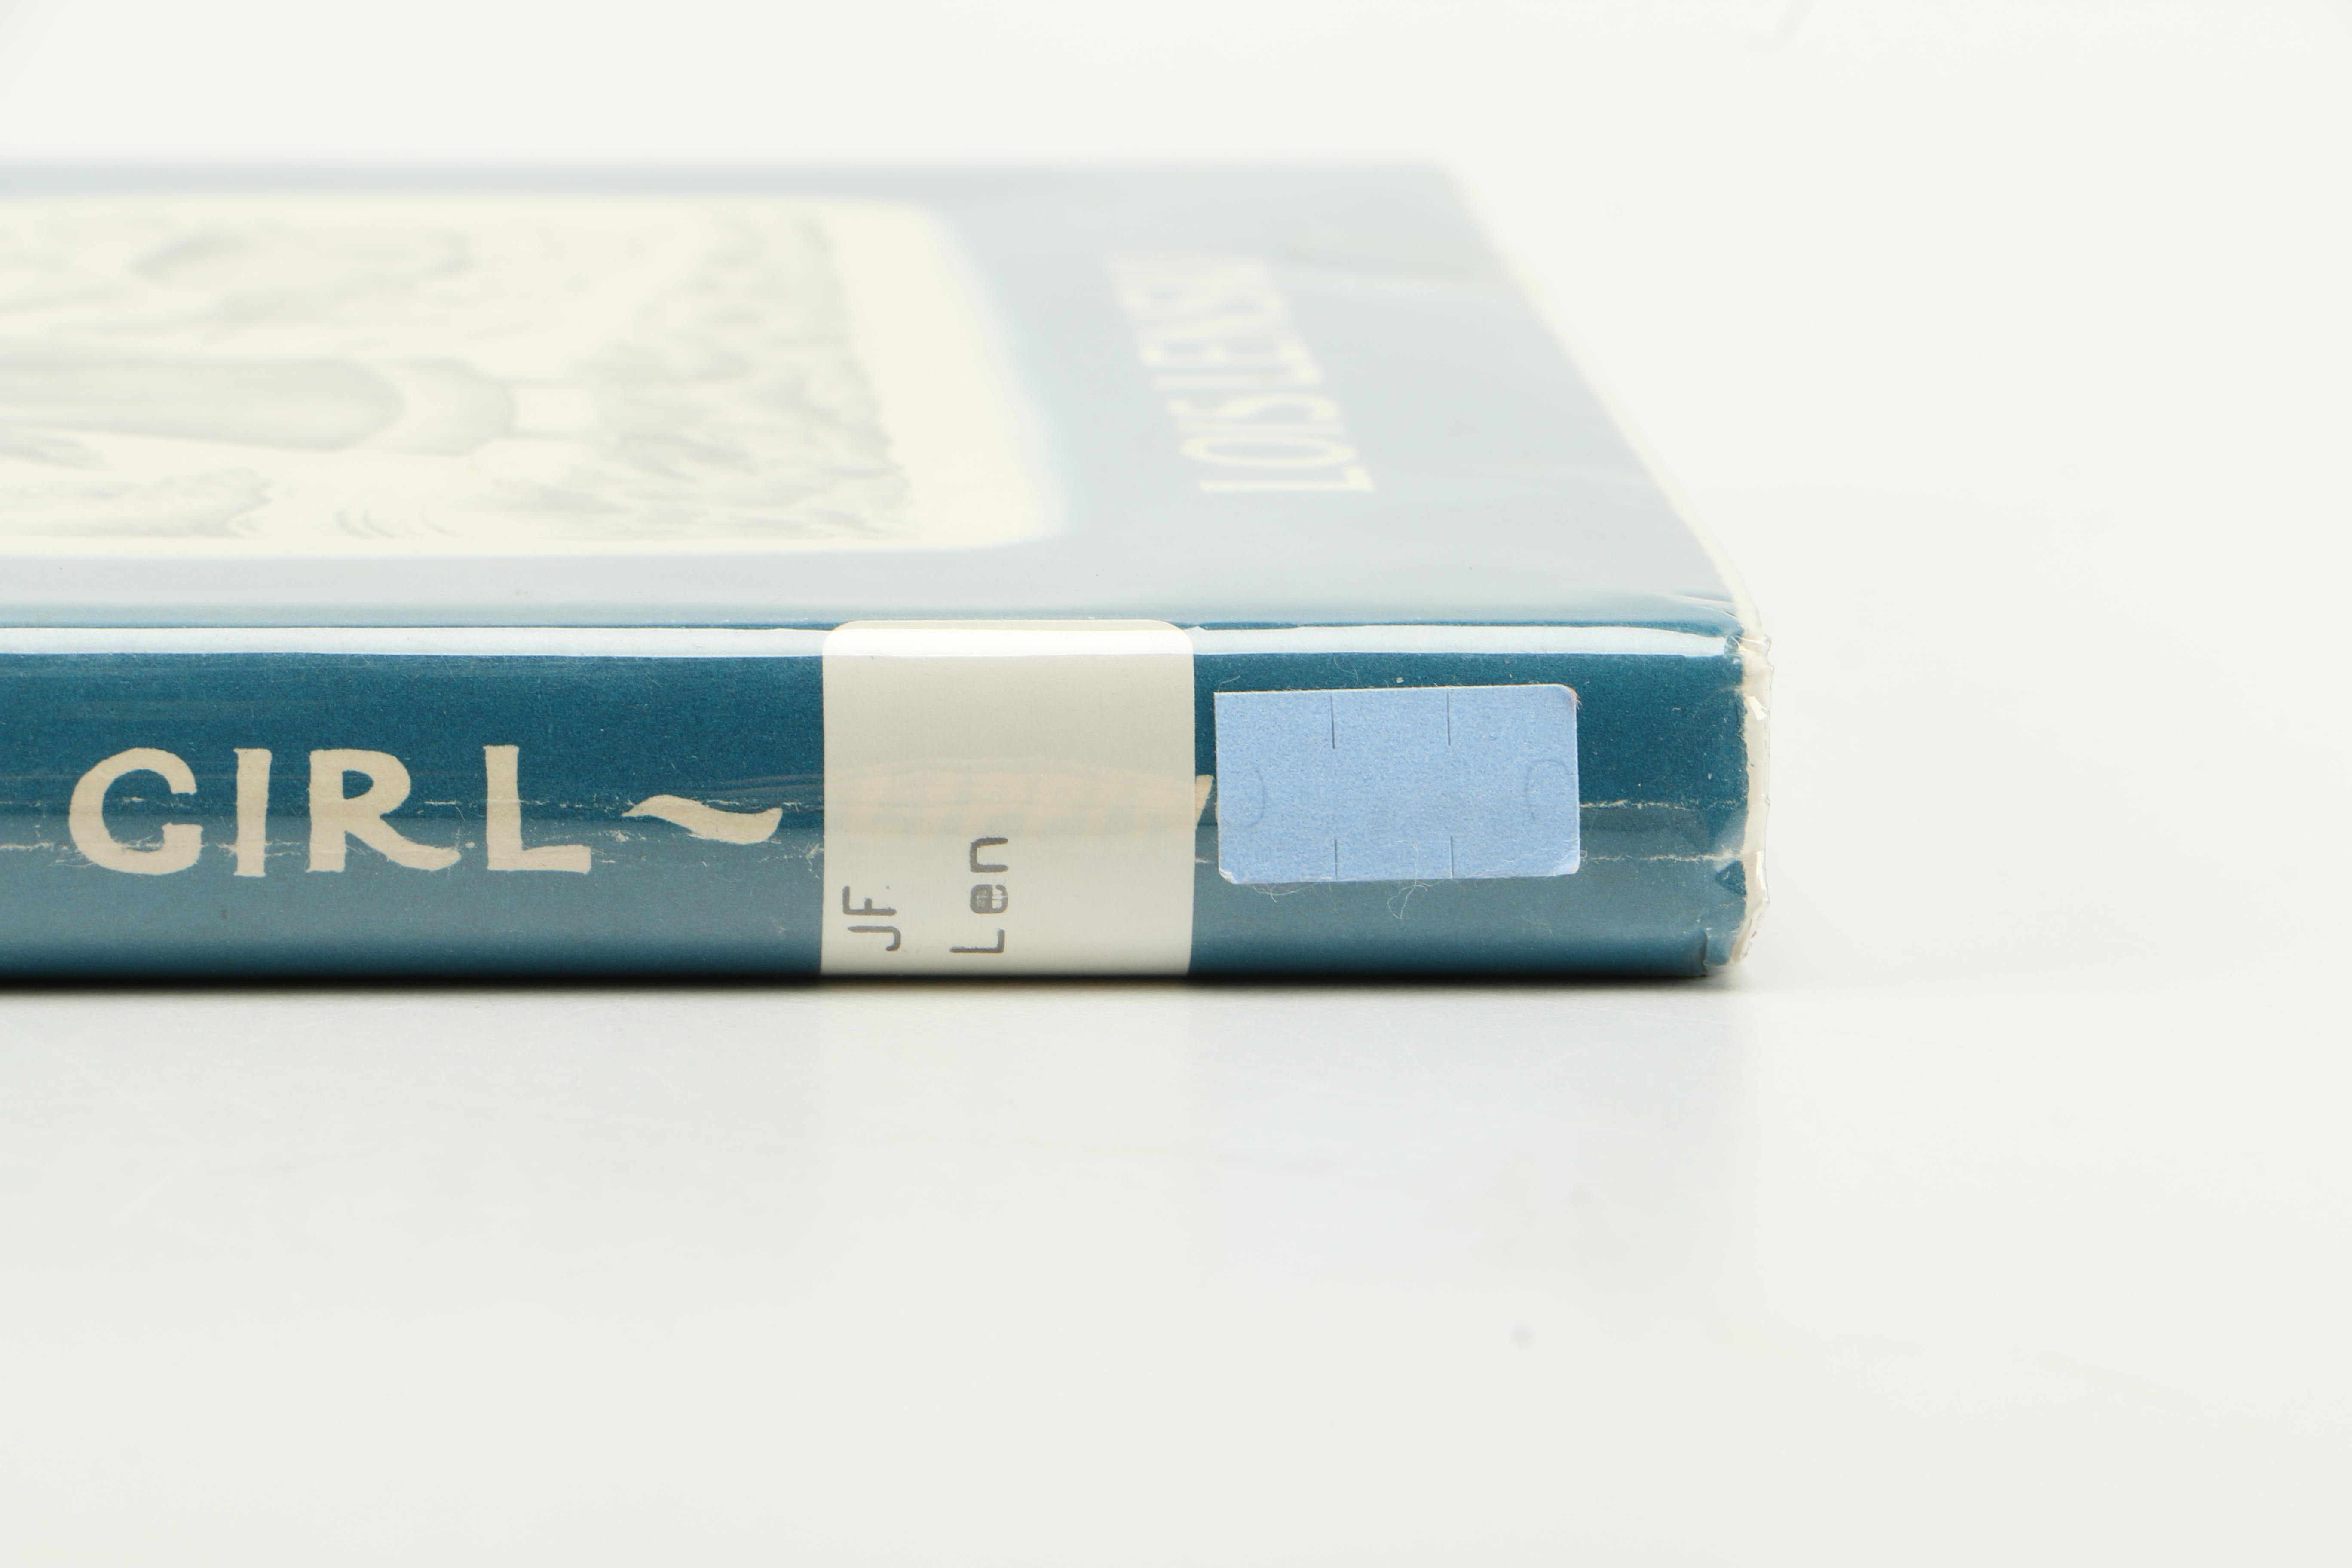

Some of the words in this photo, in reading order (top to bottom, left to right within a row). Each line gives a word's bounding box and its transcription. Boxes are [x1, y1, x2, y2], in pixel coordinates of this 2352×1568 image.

[1165, 392, 1375, 491] LOIS
[68, 745, 592, 878] GIRL
[842, 885, 902, 952] JF
[949, 836, 1009, 954] Len
